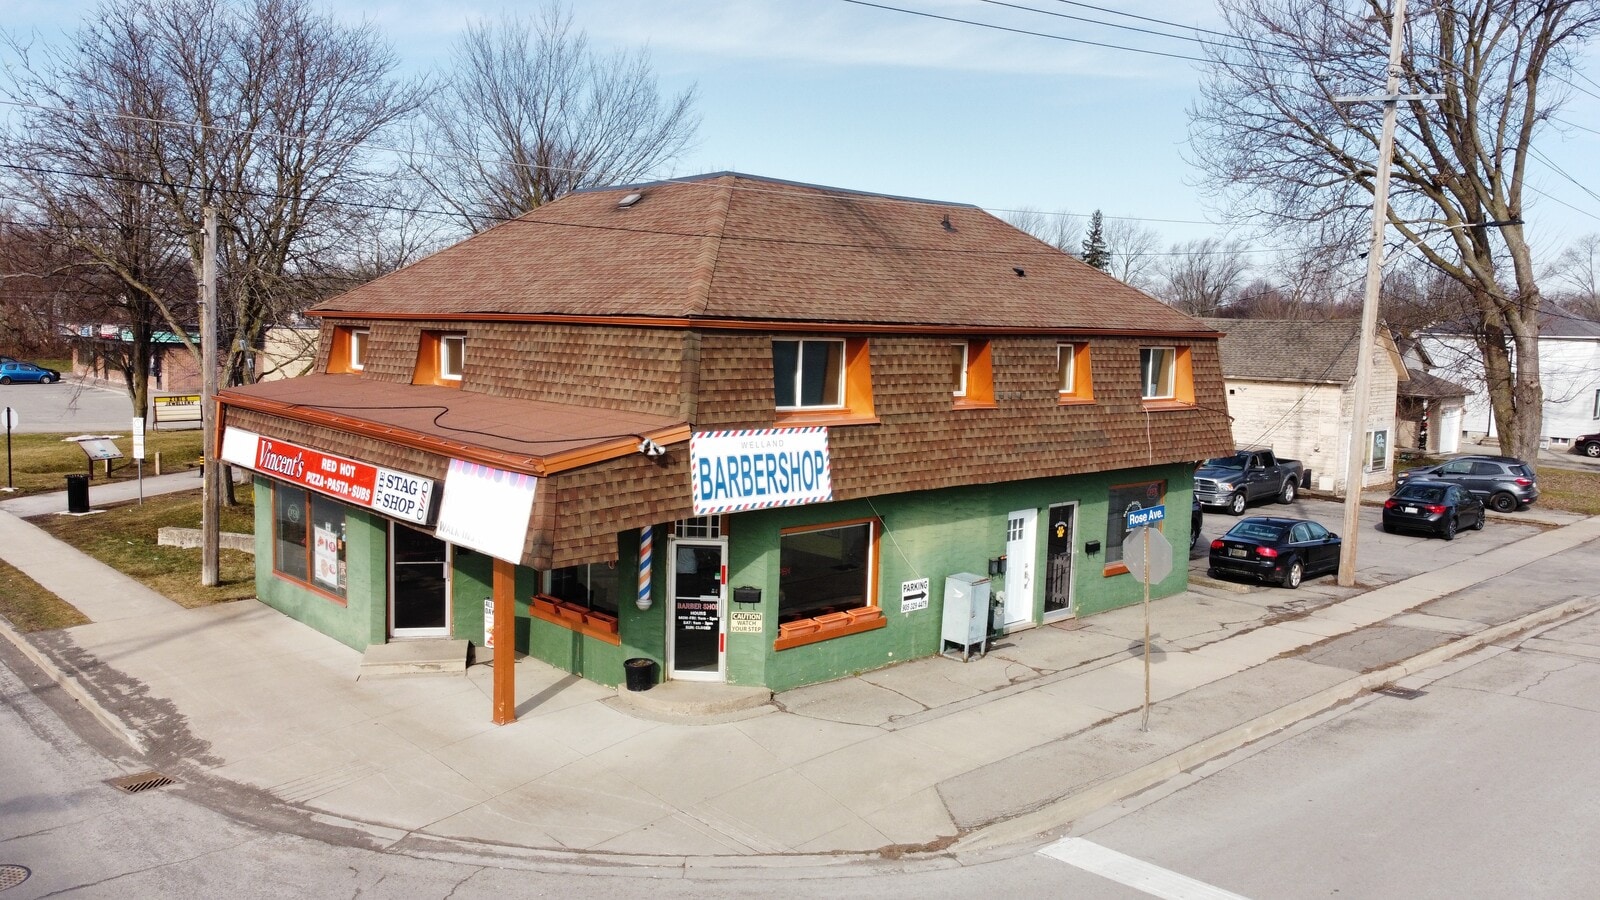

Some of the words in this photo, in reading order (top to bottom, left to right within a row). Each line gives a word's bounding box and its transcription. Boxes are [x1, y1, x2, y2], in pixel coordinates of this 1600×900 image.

[740, 439, 784, 449] WELLAND
[258, 439, 304, 478] Vincent's
[321, 458, 337, 473] RED
[340, 462, 356, 478] HOT
[386, 474, 418, 496] STAG
[698, 450, 824, 501] BARBERSHOP
[376, 471, 386, 505] THE
[382, 493, 415, 515] SHOP
[1129, 513, 1148, 525] Rose
[1148, 509, 1164, 521] Ave.
[903, 581, 927, 592] PARKING
[677, 602, 702, 610] BARBER
